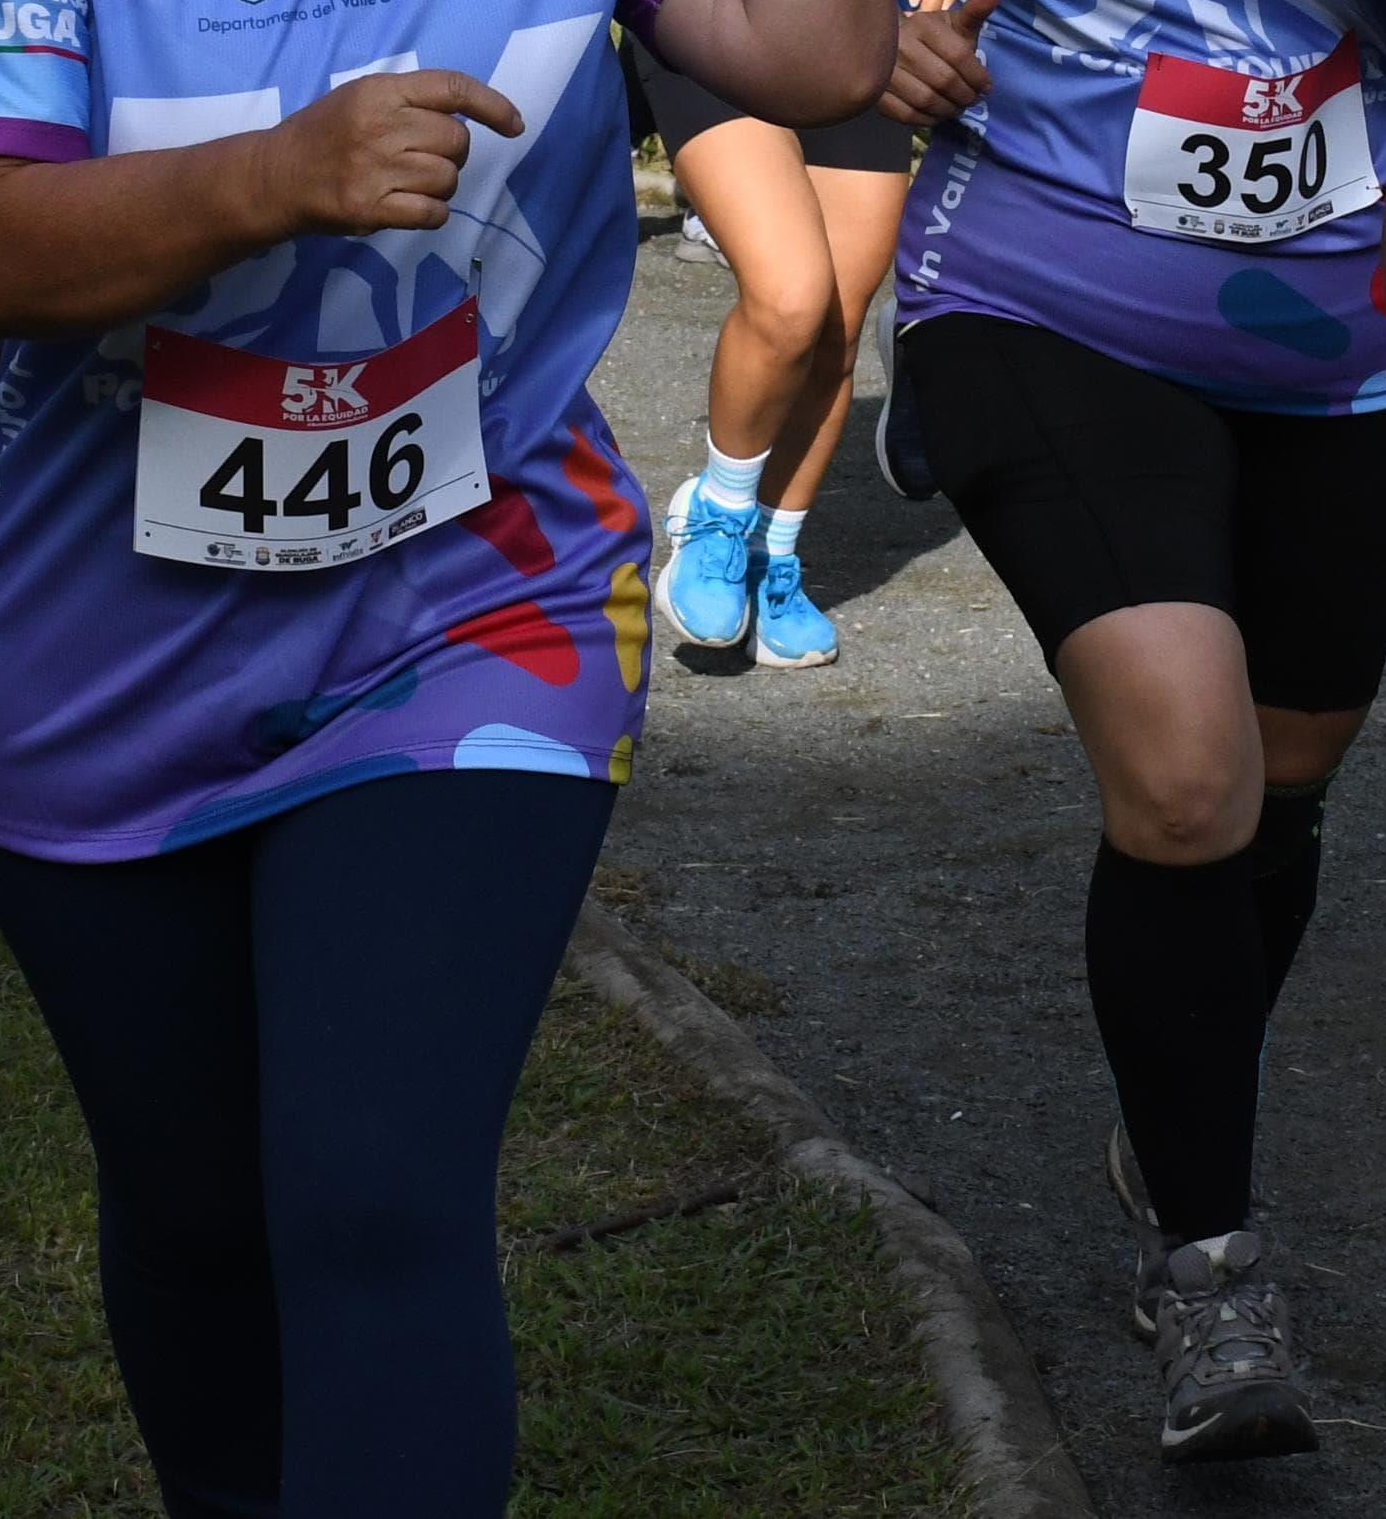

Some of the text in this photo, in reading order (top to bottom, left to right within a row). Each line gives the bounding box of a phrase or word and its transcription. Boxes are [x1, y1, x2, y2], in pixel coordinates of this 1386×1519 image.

[1241, 74, 1304, 118] 5K
[1177, 119, 1327, 214] 350
[280, 361, 370, 414] 5K
[282, 405, 370, 422] POR LA EQUIDAD
[199, 412, 426, 534] 446
